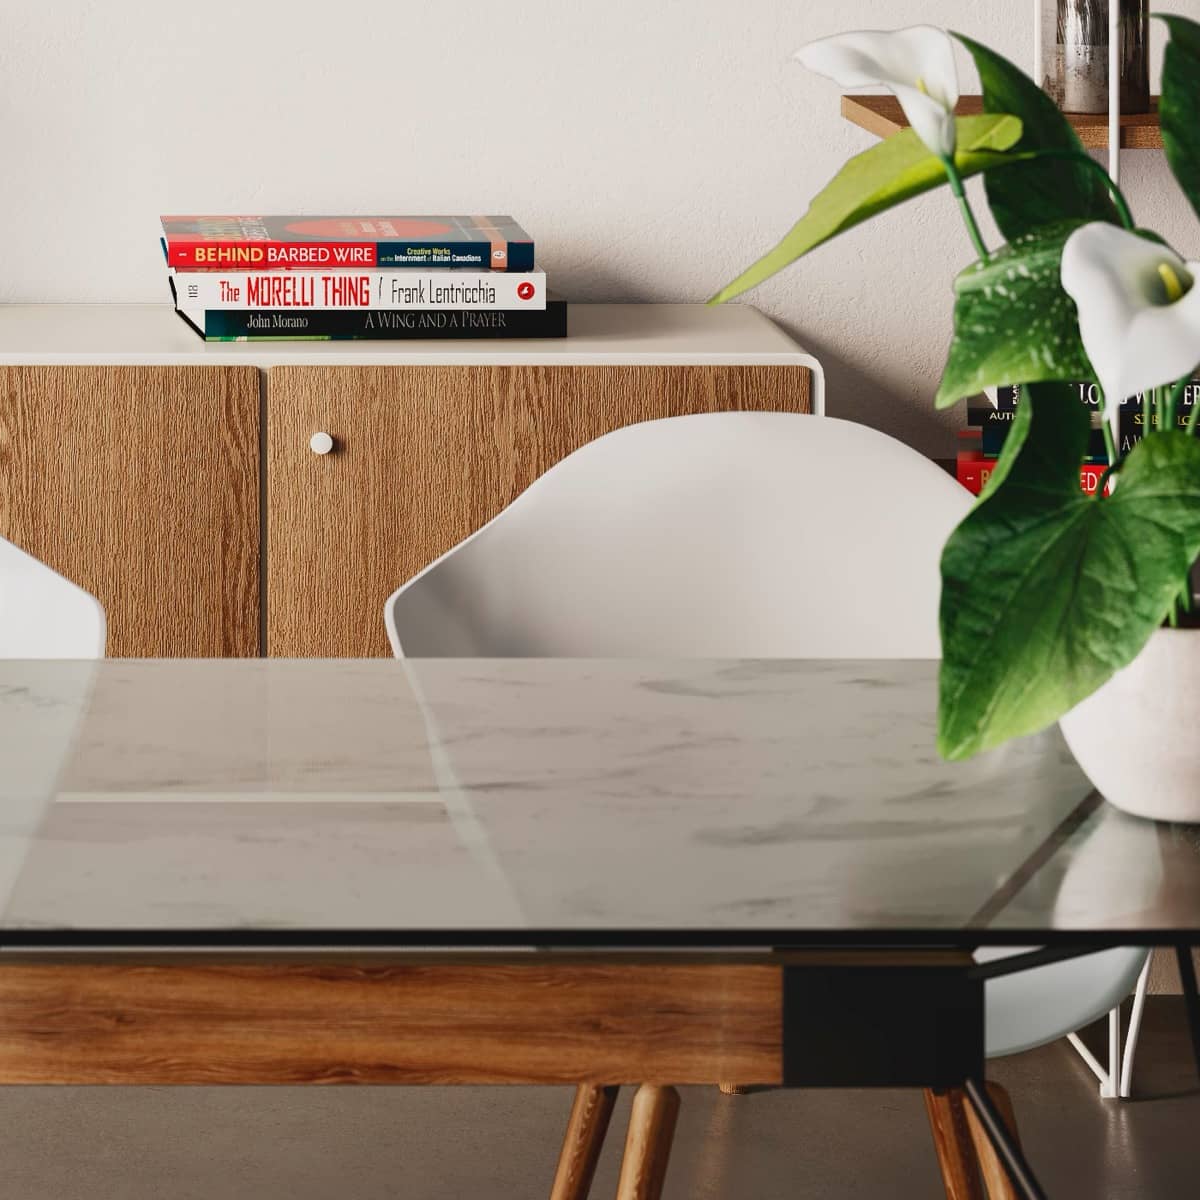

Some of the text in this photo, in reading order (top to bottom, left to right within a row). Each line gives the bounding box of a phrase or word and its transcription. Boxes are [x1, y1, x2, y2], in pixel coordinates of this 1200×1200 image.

[195, 247, 373, 262] BEHIND BARBED WIRE
[407, 247, 450, 255] Creative Works
[220, 276, 496, 306] The MORELLI THING Frank Lentricchia
[247, 315, 308, 329] John Morano
[365, 312, 375, 329] A
[377, 311, 415, 329] WING
[419, 313, 446, 328] AND
[461, 311, 507, 328] PRAYER
